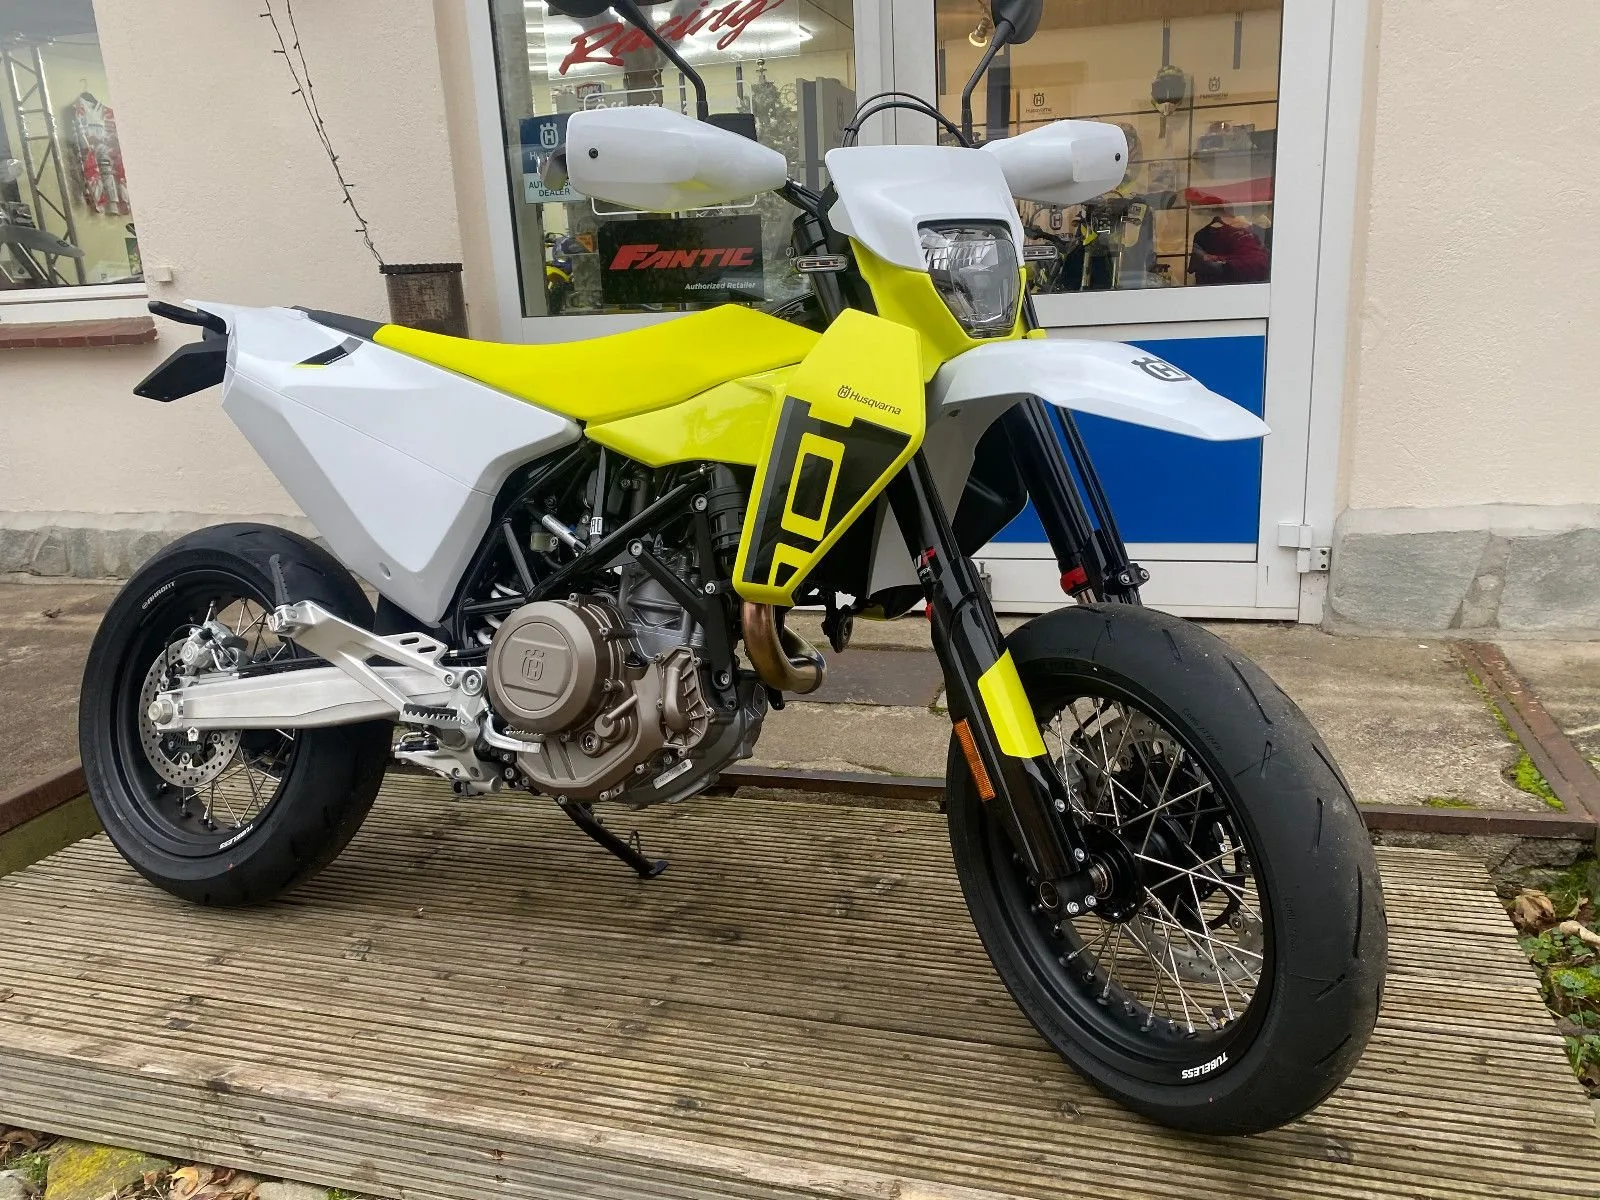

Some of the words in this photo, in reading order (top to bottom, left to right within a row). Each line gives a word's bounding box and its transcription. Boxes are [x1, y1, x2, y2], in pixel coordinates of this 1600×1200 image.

[558, 0, 784, 76] Racing
[539, 188, 571, 197] DEALER
[609, 244, 755, 270] FANTIC
[684, 283, 726, 291] Authorized
[727, 281, 756, 289] Retailer
[849, 391, 902, 416] Husqvarna
[1181, 1051, 1229, 1079] TUBELESS
